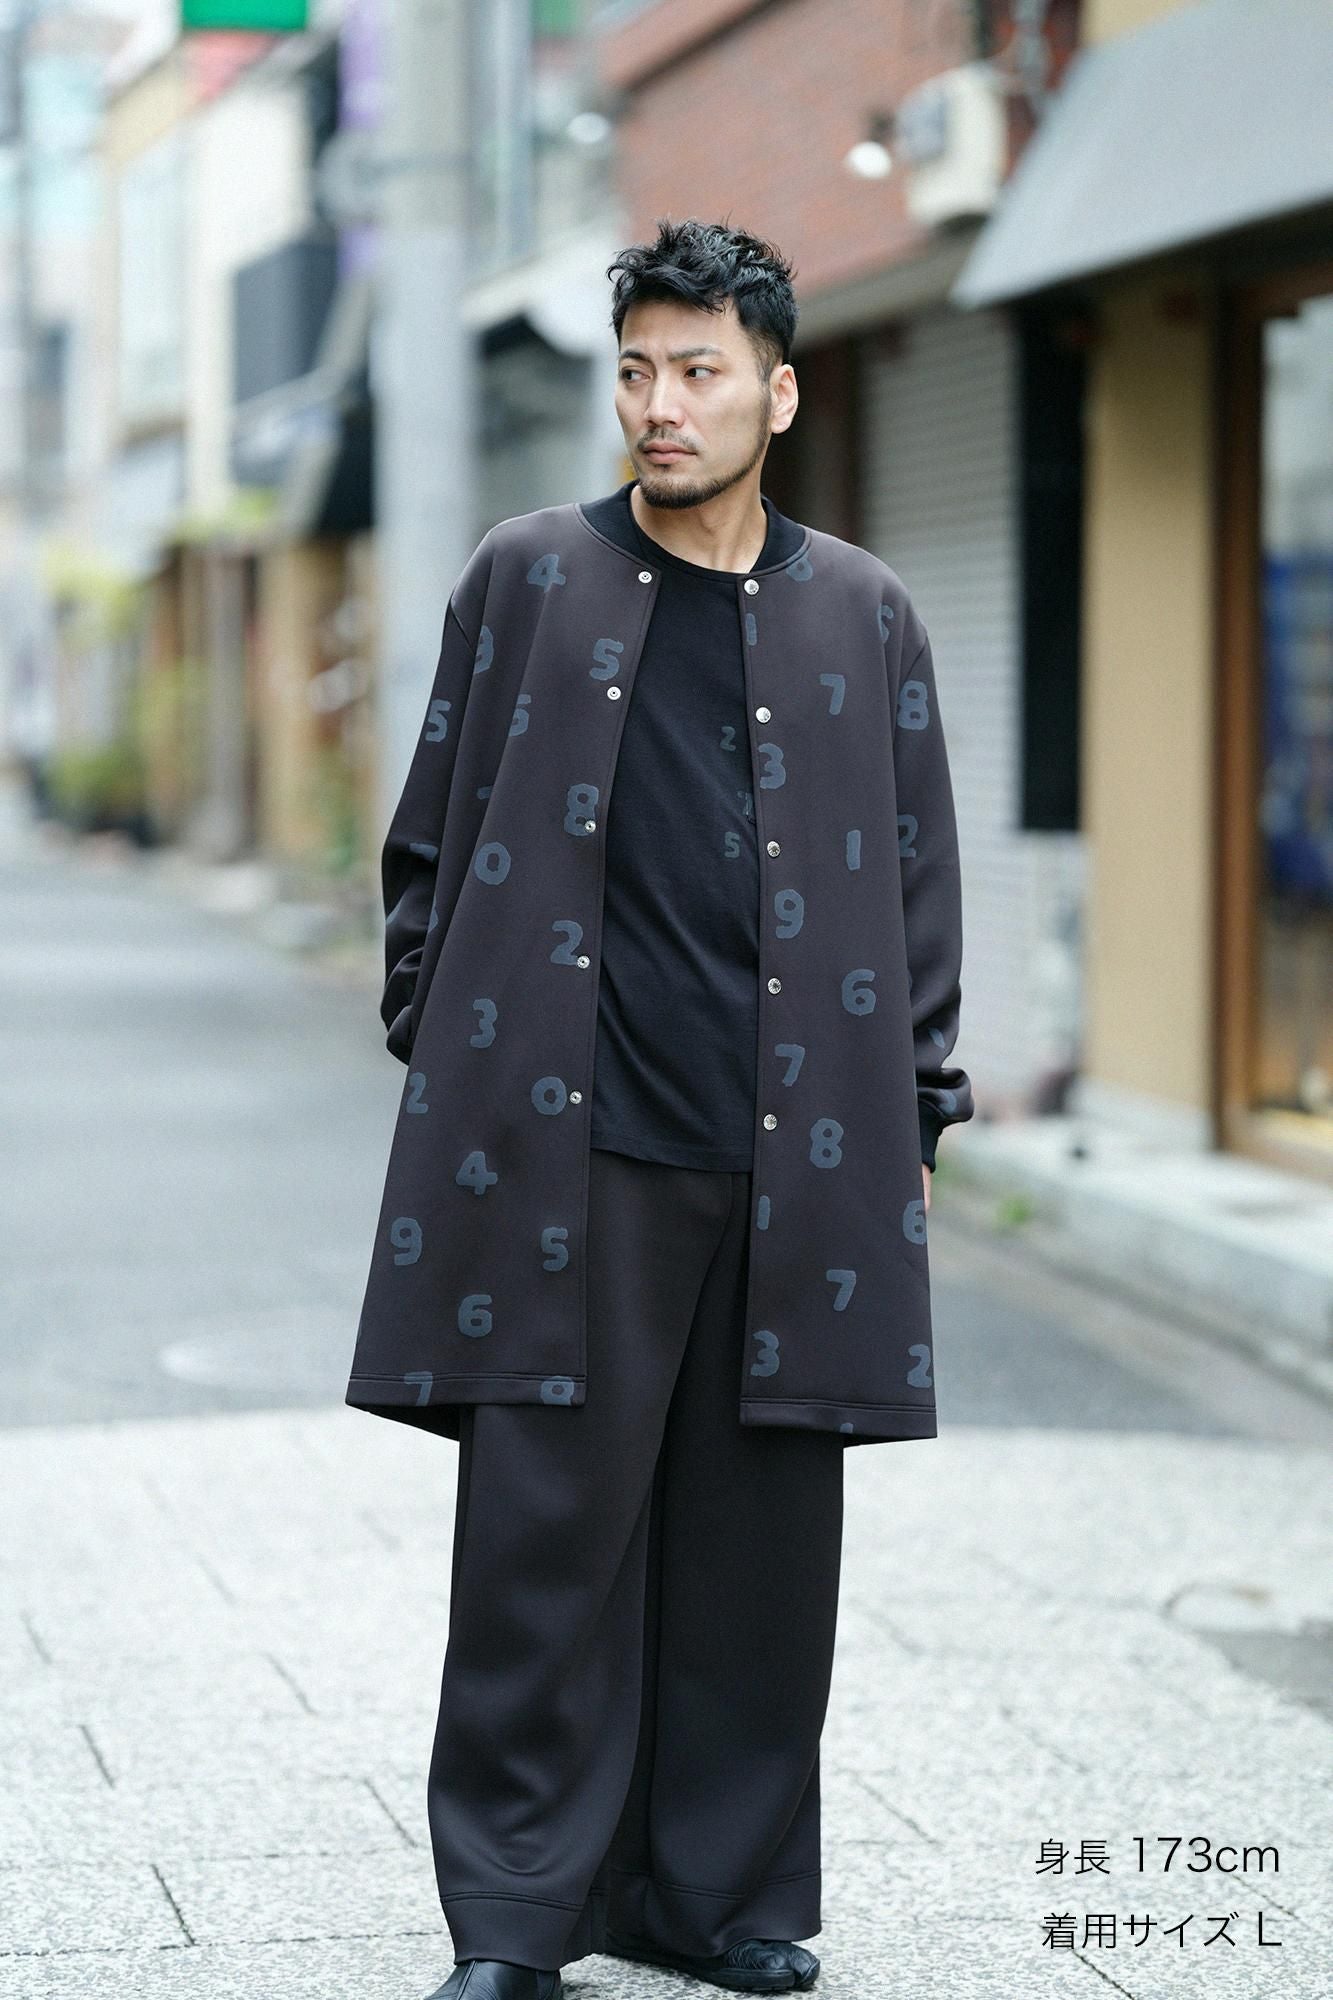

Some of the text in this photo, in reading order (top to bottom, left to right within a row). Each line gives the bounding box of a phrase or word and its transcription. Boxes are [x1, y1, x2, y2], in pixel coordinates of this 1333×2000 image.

[527, 553, 566, 592] 4
[589, 638, 625, 680] 5
[819, 673, 846, 716] 7
[897, 680, 929, 730] 8
[424, 699, 451, 742] 5
[719, 726, 736, 752] 2
[758, 743, 786, 790] 3
[563, 783, 599, 836] 8
[473, 841, 511, 885] 0
[724, 831, 740, 858] 5
[774, 888, 805, 938] 9
[550, 919, 583, 965] 2
[841, 968, 877, 1016] 6
[470, 998, 498, 1048] 3
[774, 1043, 806, 1087] 7
[406, 1071, 429, 1114] 2
[530, 1075, 568, 1115] 0
[809, 1117, 844, 1169] 8
[455, 1150, 498, 1195] 4
[390, 1216, 423, 1266] 9
[902, 1199, 928, 1245] 6
[540, 1226, 569, 1272] 5
[826, 1269, 857, 1312] 7
[457, 1294, 493, 1338] 6
[750, 1330, 780, 1377] 3
[906, 1343, 933, 1389] 2
[404, 1371, 433, 1406] 7
